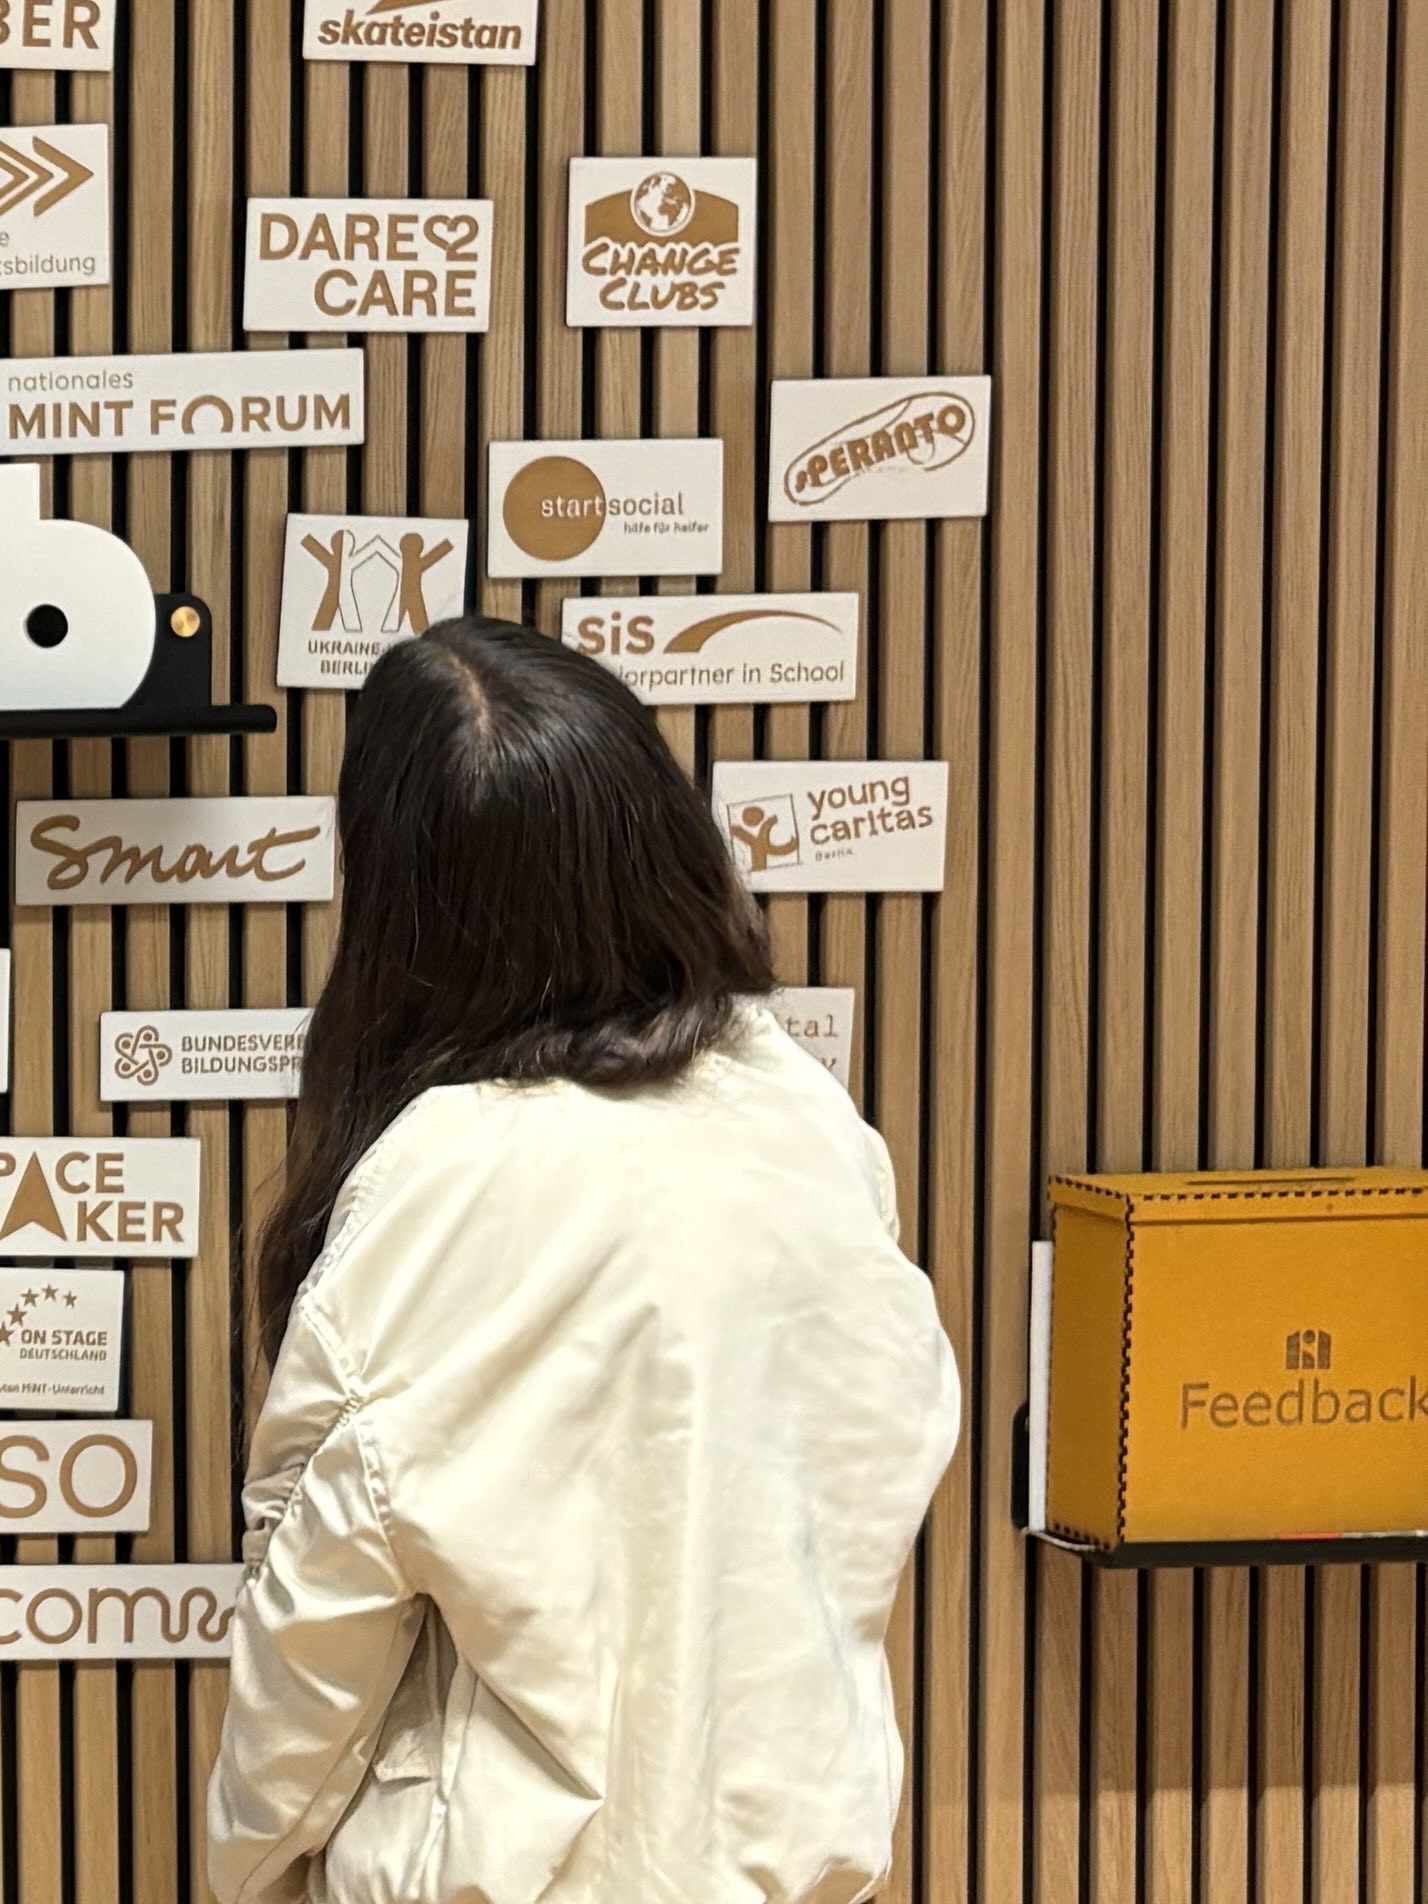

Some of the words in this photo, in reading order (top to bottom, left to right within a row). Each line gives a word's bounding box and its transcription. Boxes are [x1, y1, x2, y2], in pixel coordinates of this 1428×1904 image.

[318, 10, 522, 50] skateistan
[259, 212, 418, 262] DARE
[581, 239, 741, 277] CHANGE
[313, 268, 476, 317] CARE
[598, 277, 727, 312] CLUBS
[7, 369, 134, 393] nationales
[8, 399, 134, 440] MINT
[150, 393, 351, 436] FORUM
[320, 660, 373, 676] BERLI
[742, 663, 761, 684] in
[807, 775, 910, 821] young
[29, 814, 321, 891] Smart
[19, 1348, 107, 1362] DEUTSCHLAND
[20, 1328, 47, 1345] ON
[51, 1329, 108, 1347] STAGE
